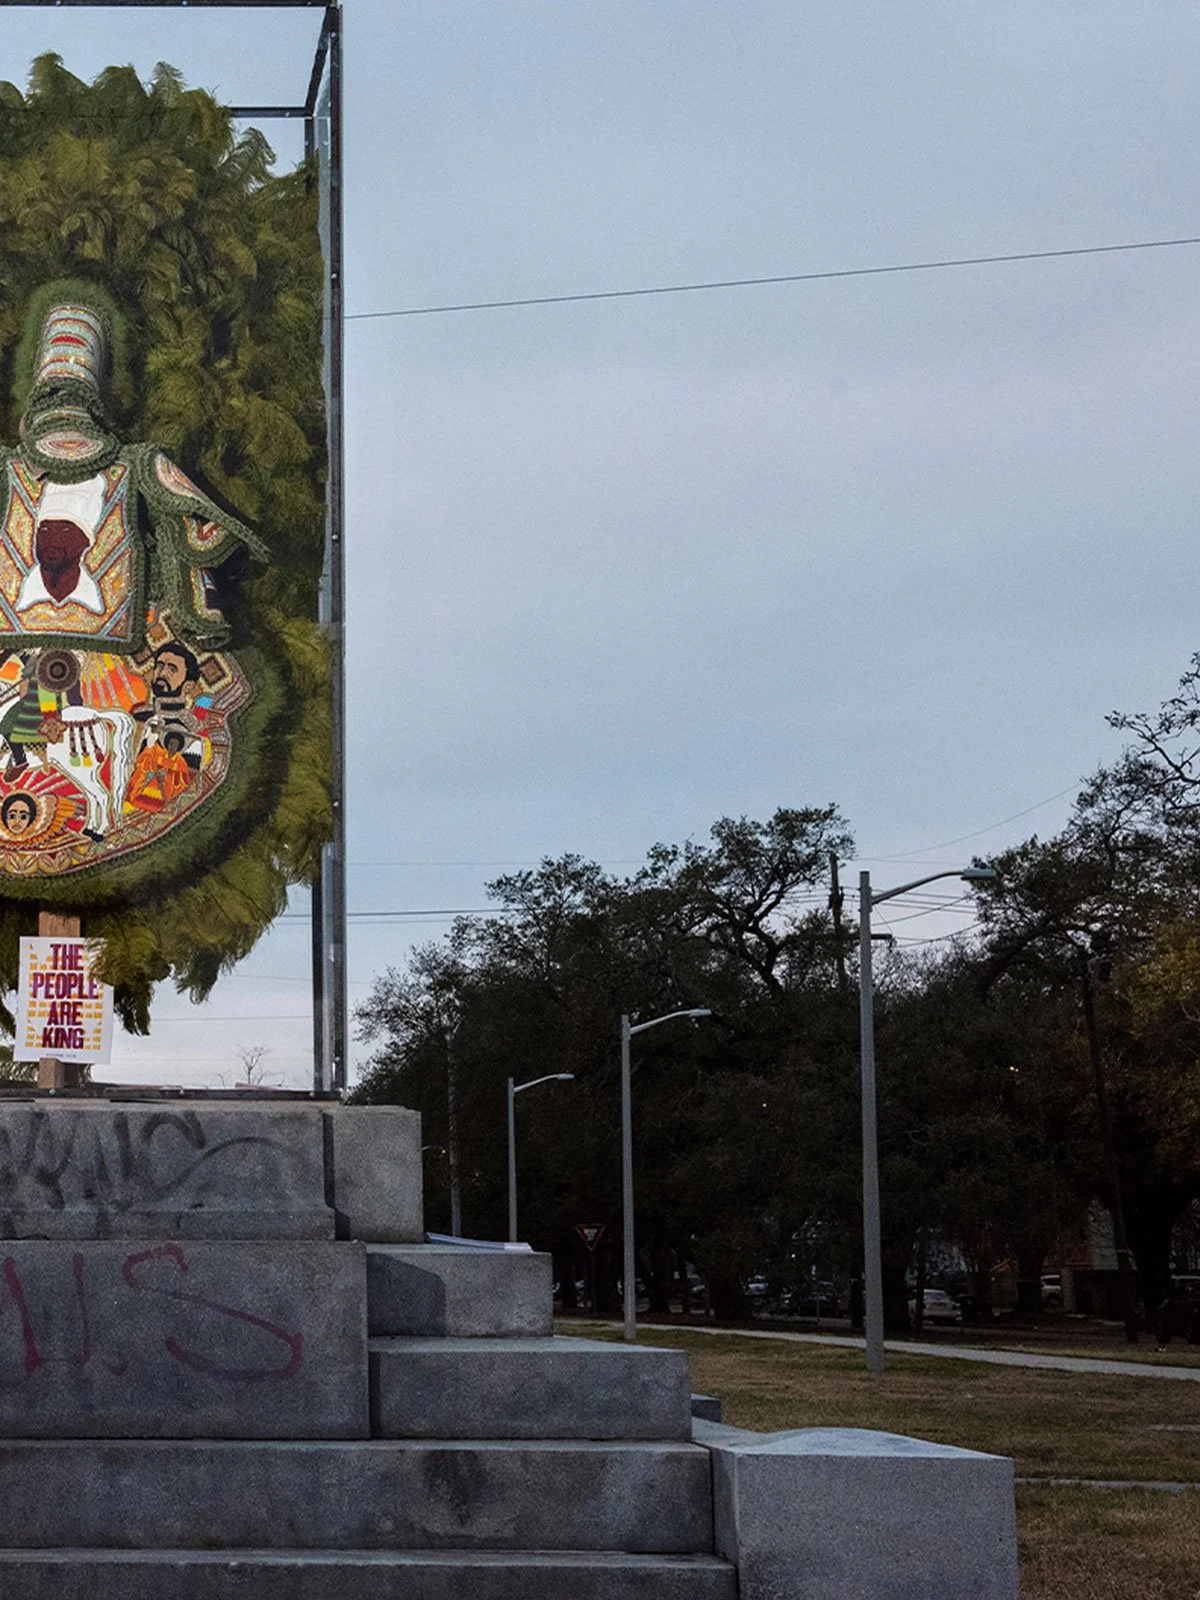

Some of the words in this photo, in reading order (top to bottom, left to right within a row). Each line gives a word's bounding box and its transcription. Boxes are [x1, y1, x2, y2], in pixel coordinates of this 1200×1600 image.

[50, 944, 84, 970] THE
[32, 972, 99, 999] PEOPLE
[47, 1001, 83, 1026] ARE
[42, 1027, 84, 1049] KING
